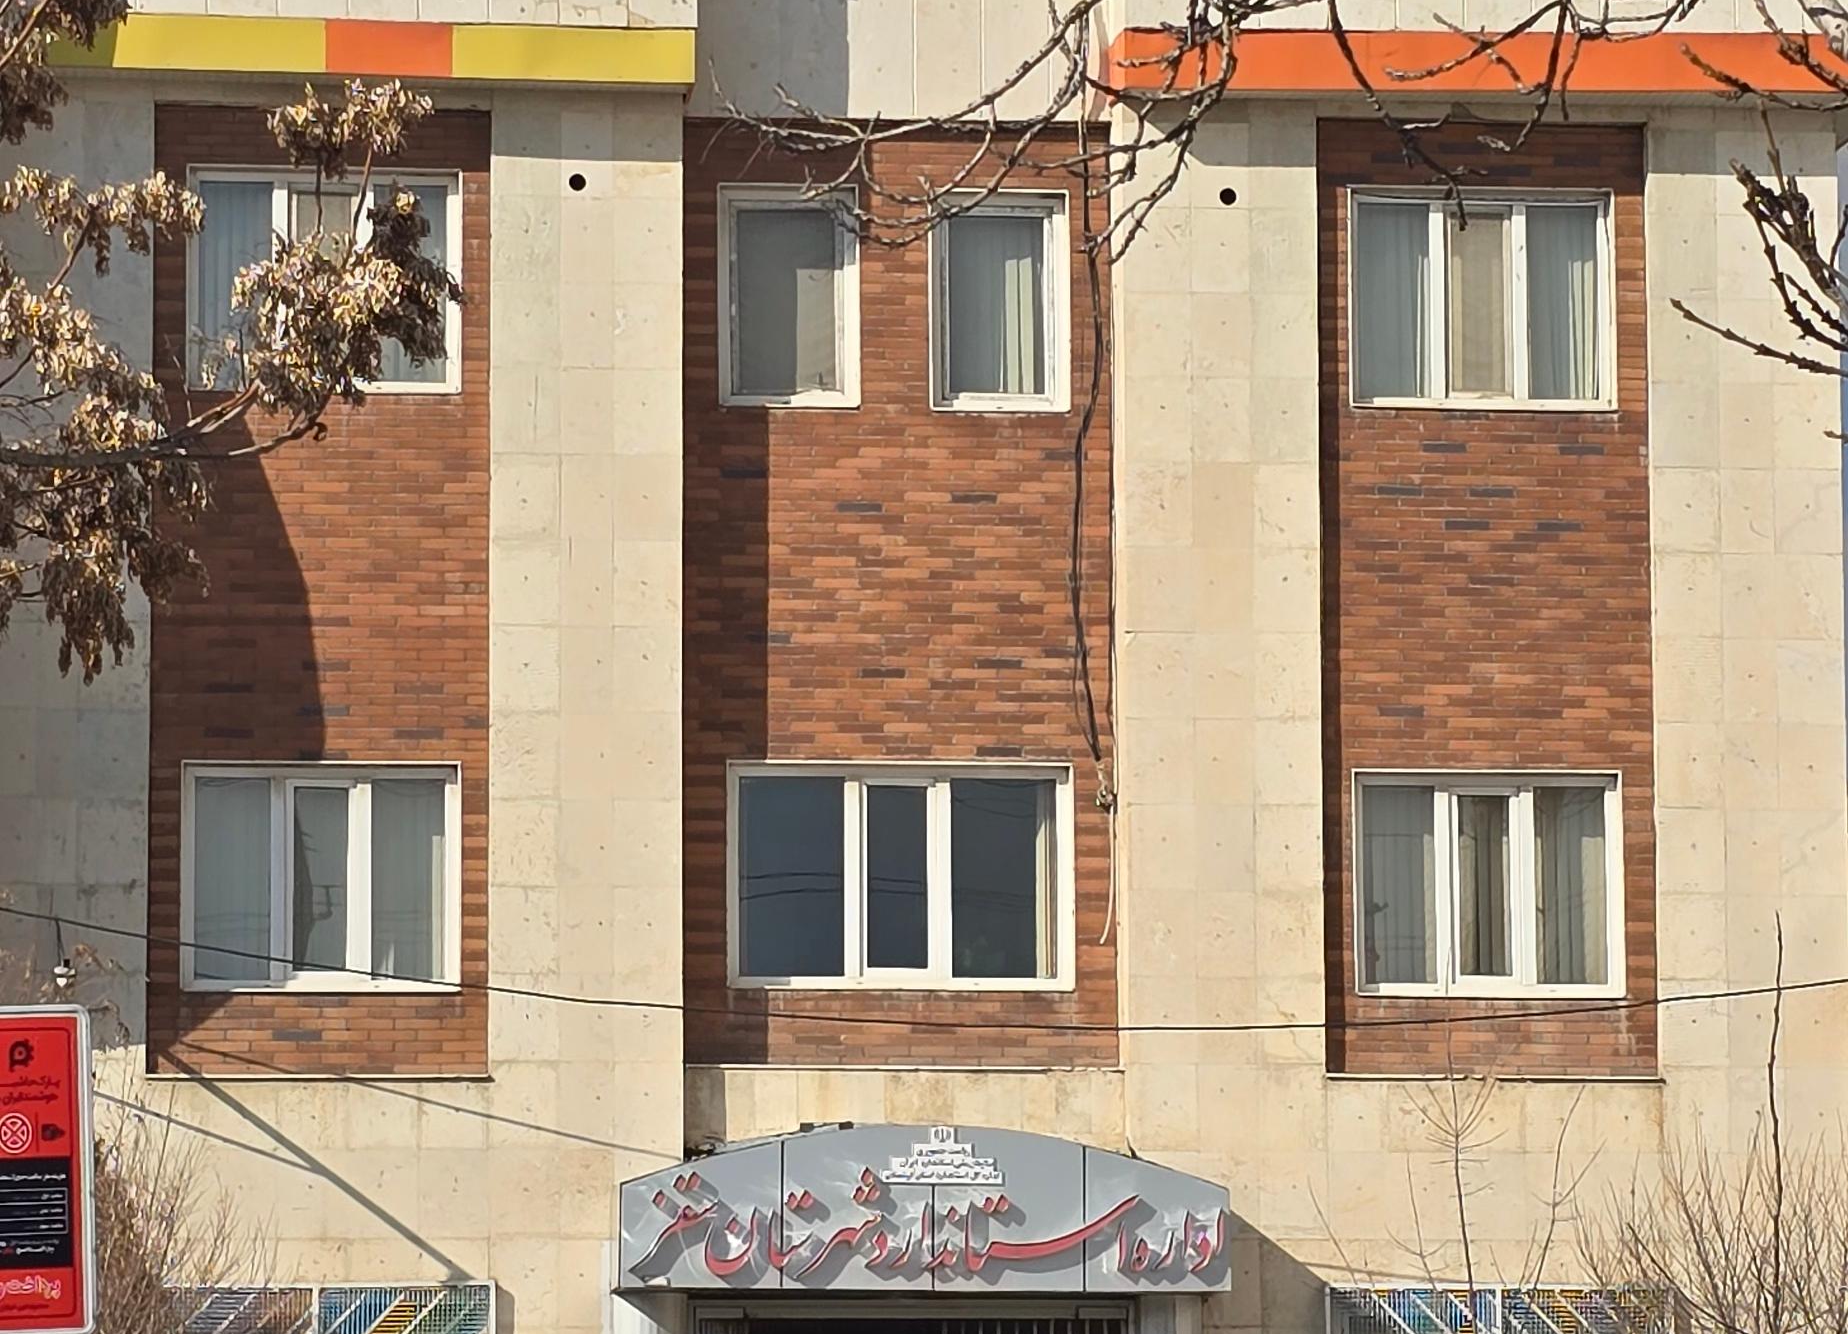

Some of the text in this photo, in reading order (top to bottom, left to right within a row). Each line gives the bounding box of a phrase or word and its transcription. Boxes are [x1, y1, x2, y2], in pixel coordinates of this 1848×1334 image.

[627, 1170, 721, 1275] سقز
[704, 1166, 884, 1280] شهرستان
[864, 1193, 1141, 1274] استاندارد
